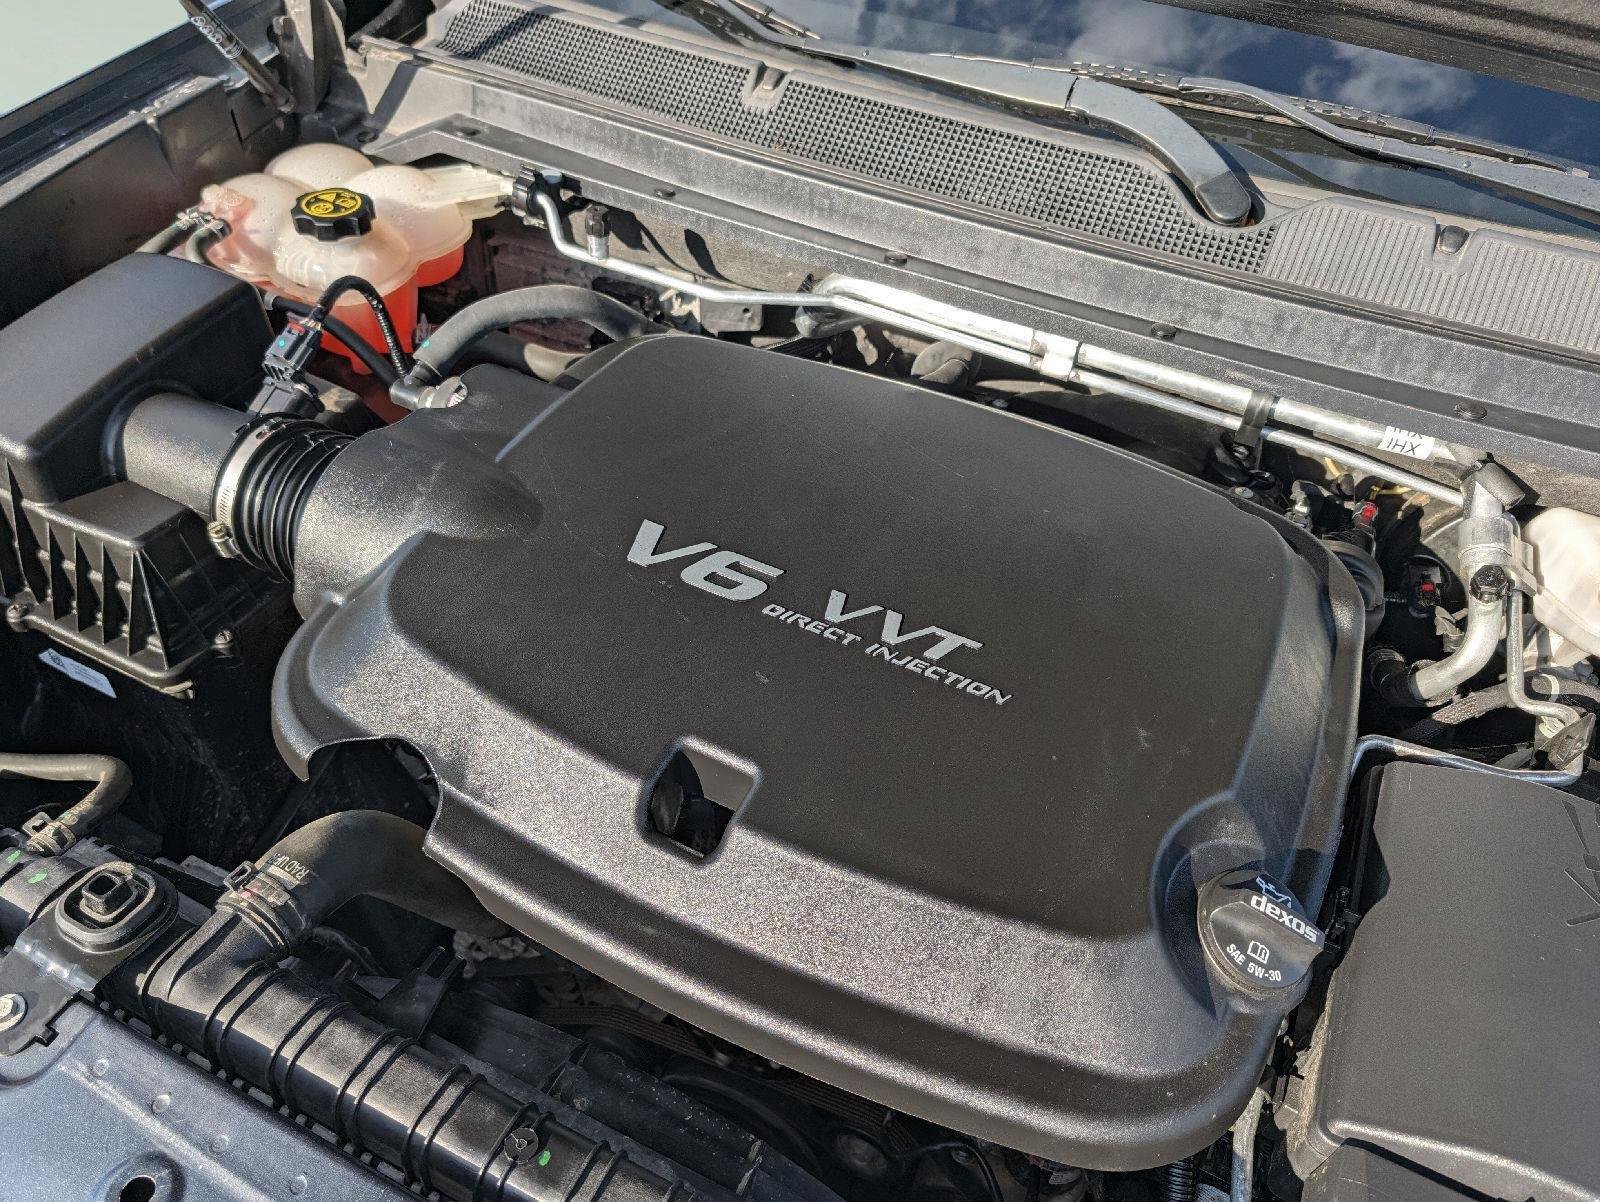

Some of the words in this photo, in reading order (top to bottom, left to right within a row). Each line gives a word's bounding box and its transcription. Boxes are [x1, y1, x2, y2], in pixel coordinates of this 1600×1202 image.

[627, 518, 786, 602] V6
[761, 603, 863, 646] DIRECT
[864, 643, 1012, 706] INJECTION
[824, 589, 984, 661] VVT
[285, 860, 310, 880] RAD
[1250, 895, 1318, 943] dexos
[1226, 943, 1246, 966] SAE
[1247, 963, 1282, 982] 5W-30
